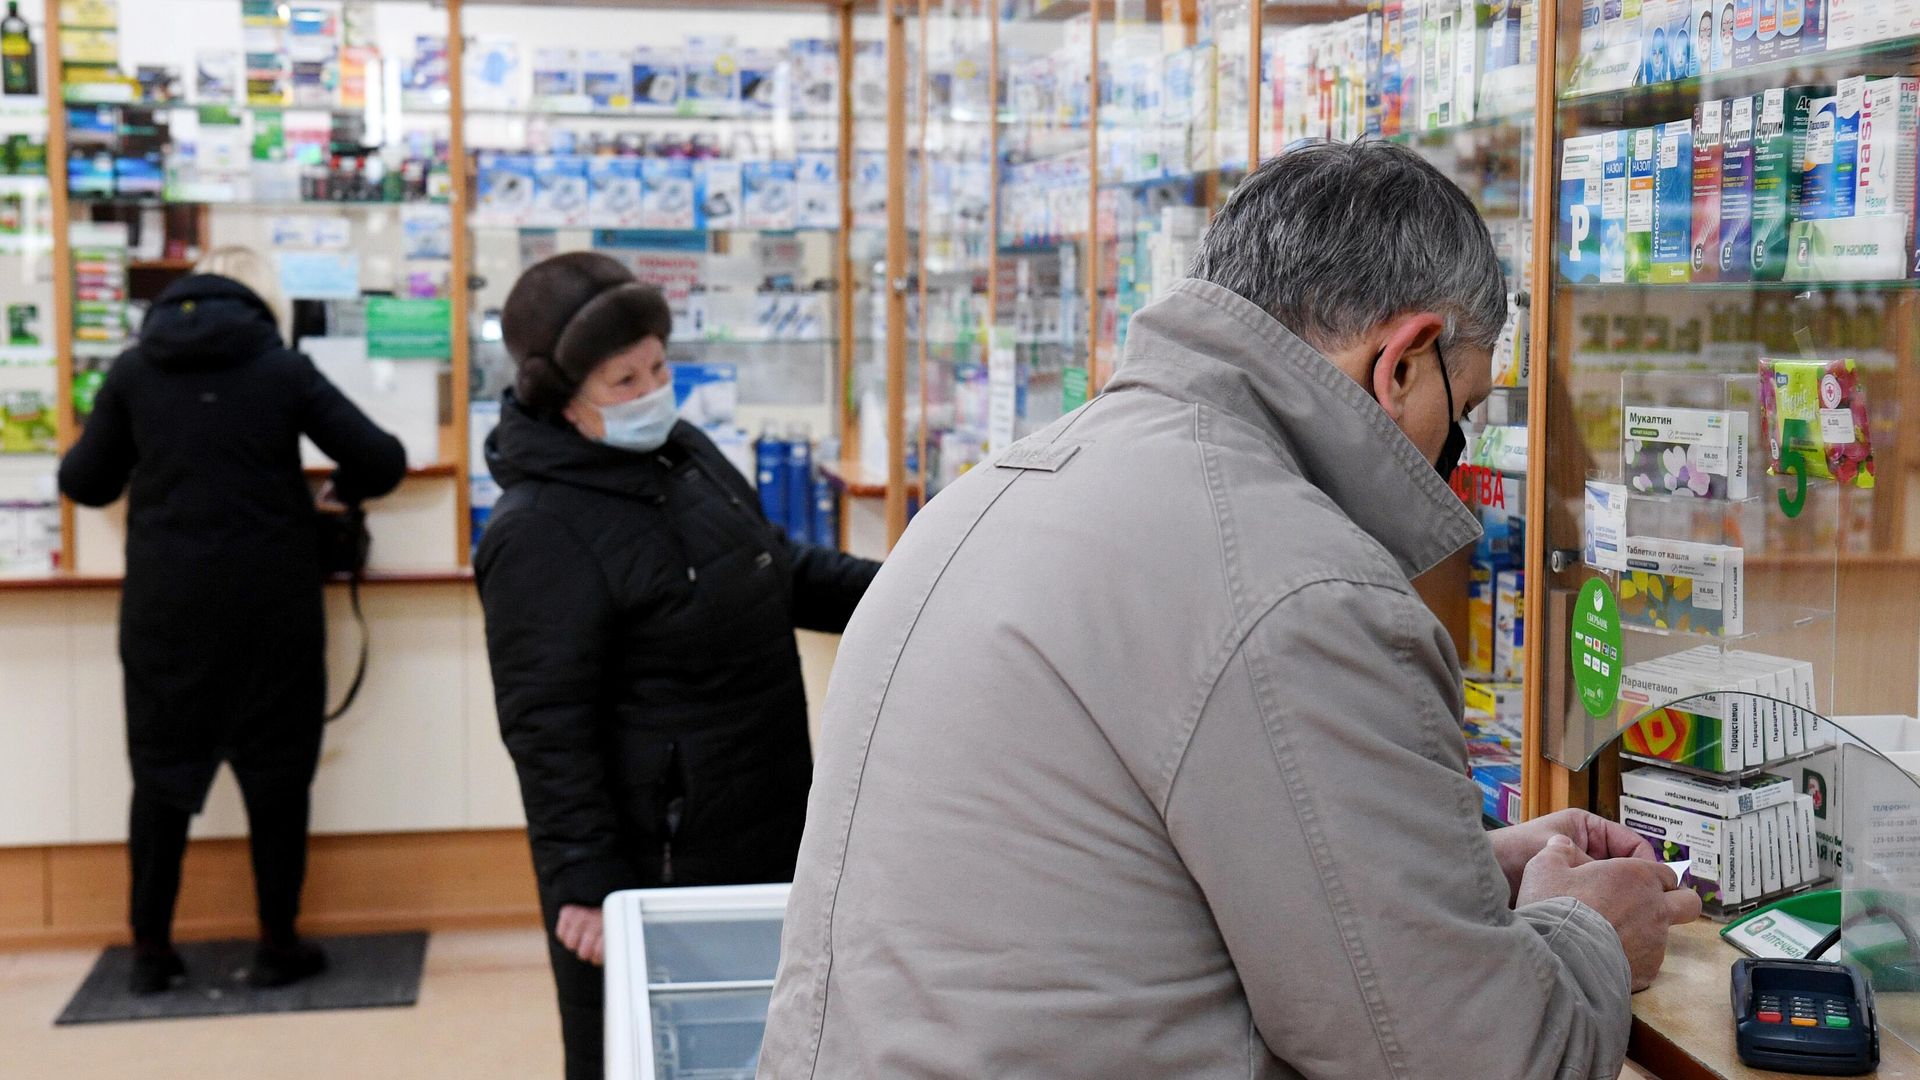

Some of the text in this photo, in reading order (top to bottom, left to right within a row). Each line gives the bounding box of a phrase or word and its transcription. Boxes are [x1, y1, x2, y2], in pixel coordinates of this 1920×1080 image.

[1859, 89, 1873, 187] nasic
[1605, 161, 1624, 174] НАЗОЛ
[1631, 160, 1652, 173] НАЗОЛ
[1653, 133, 1662, 258] РИНОФЛУИМУЦИЛ
[1629, 412, 1672, 426] Мукалтин
[1736, 434, 1744, 478] Мукалтин
[1778, 418, 1807, 519] 5
[1626, 545, 1690, 562] Таблетки от кашля
[1621, 674, 1679, 696] Парацетамол
[1730, 702, 1739, 754] Парацетамол
[1624, 804, 1684, 827] Пустырника экстракт
[1760, 932, 1804, 958] аптечная
